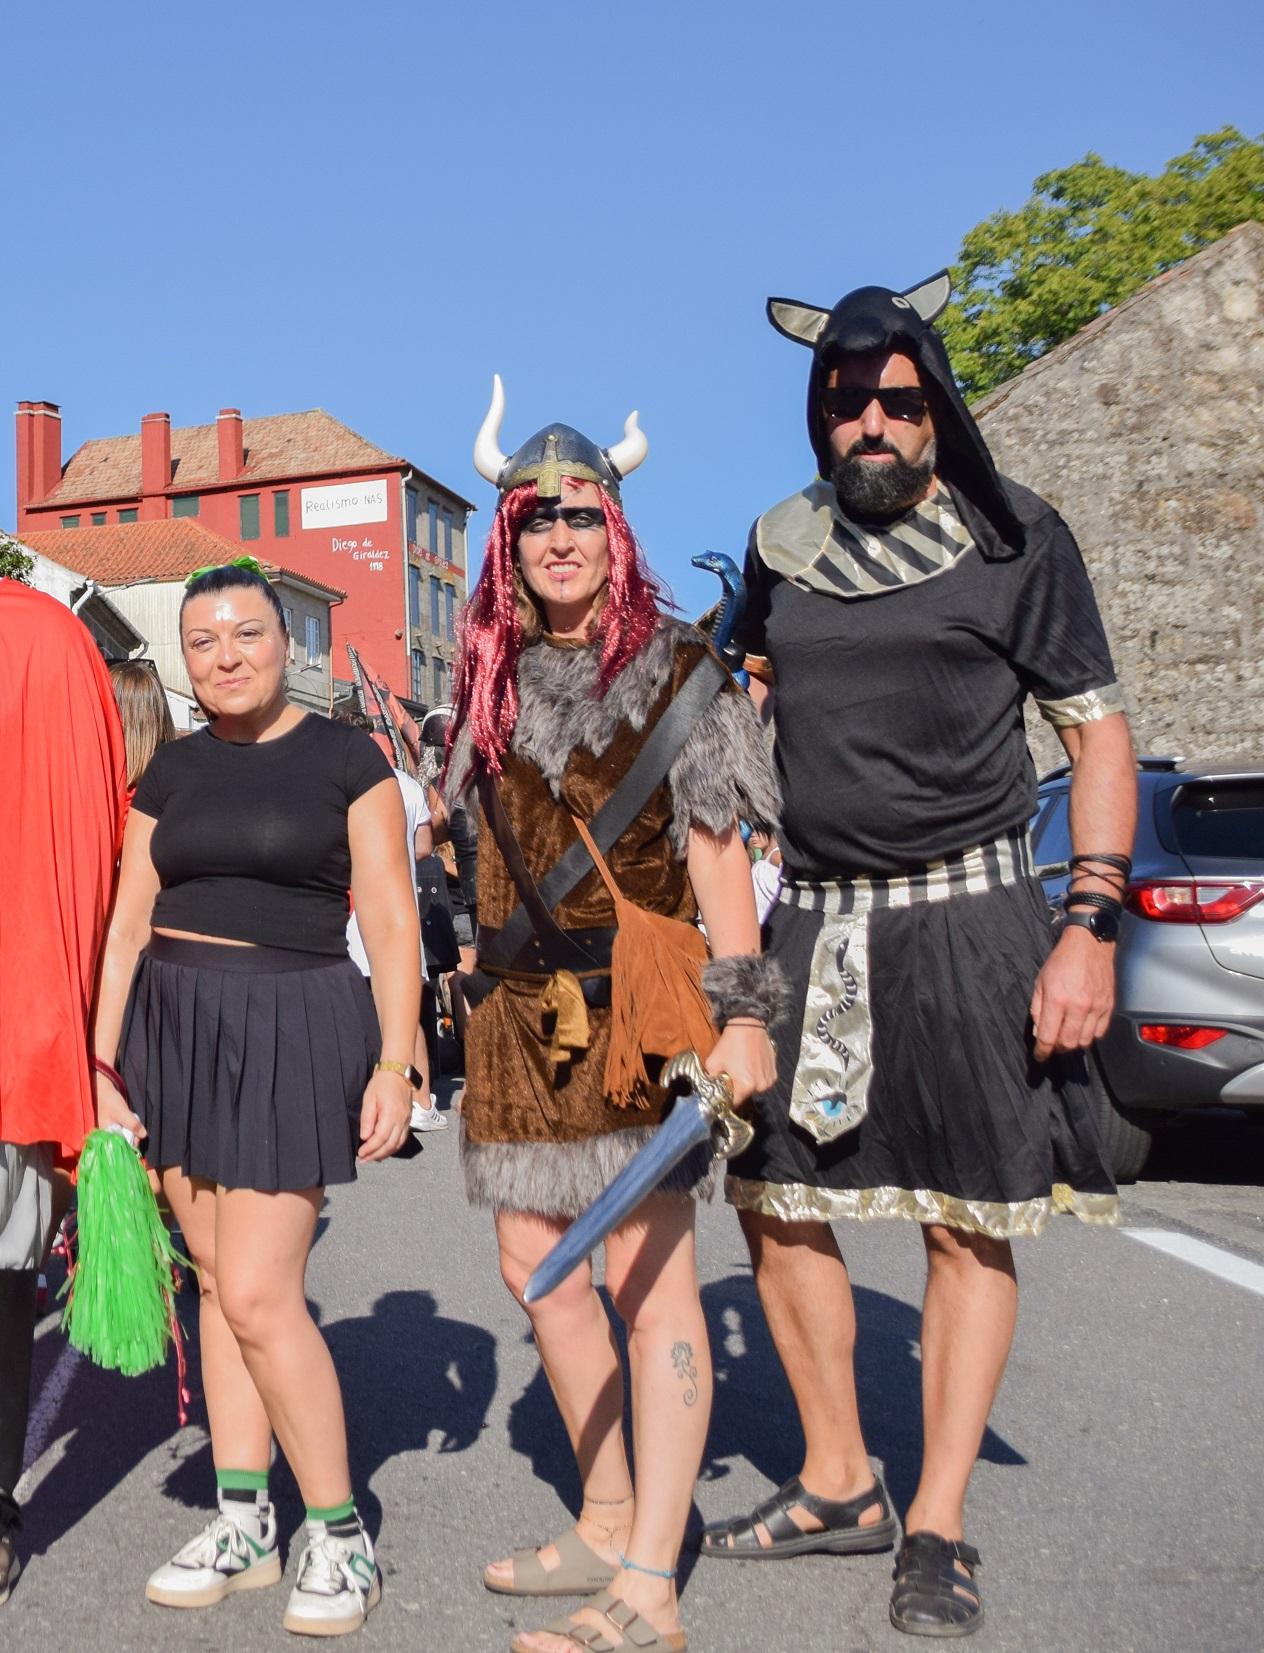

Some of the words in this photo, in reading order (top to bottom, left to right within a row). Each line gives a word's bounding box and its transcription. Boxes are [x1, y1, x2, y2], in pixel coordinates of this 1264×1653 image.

[305, 497, 359, 513] Realismo
[364, 492, 383, 505] NAS
[332, 537, 358, 552] Diego
[362, 537, 374, 547] de
